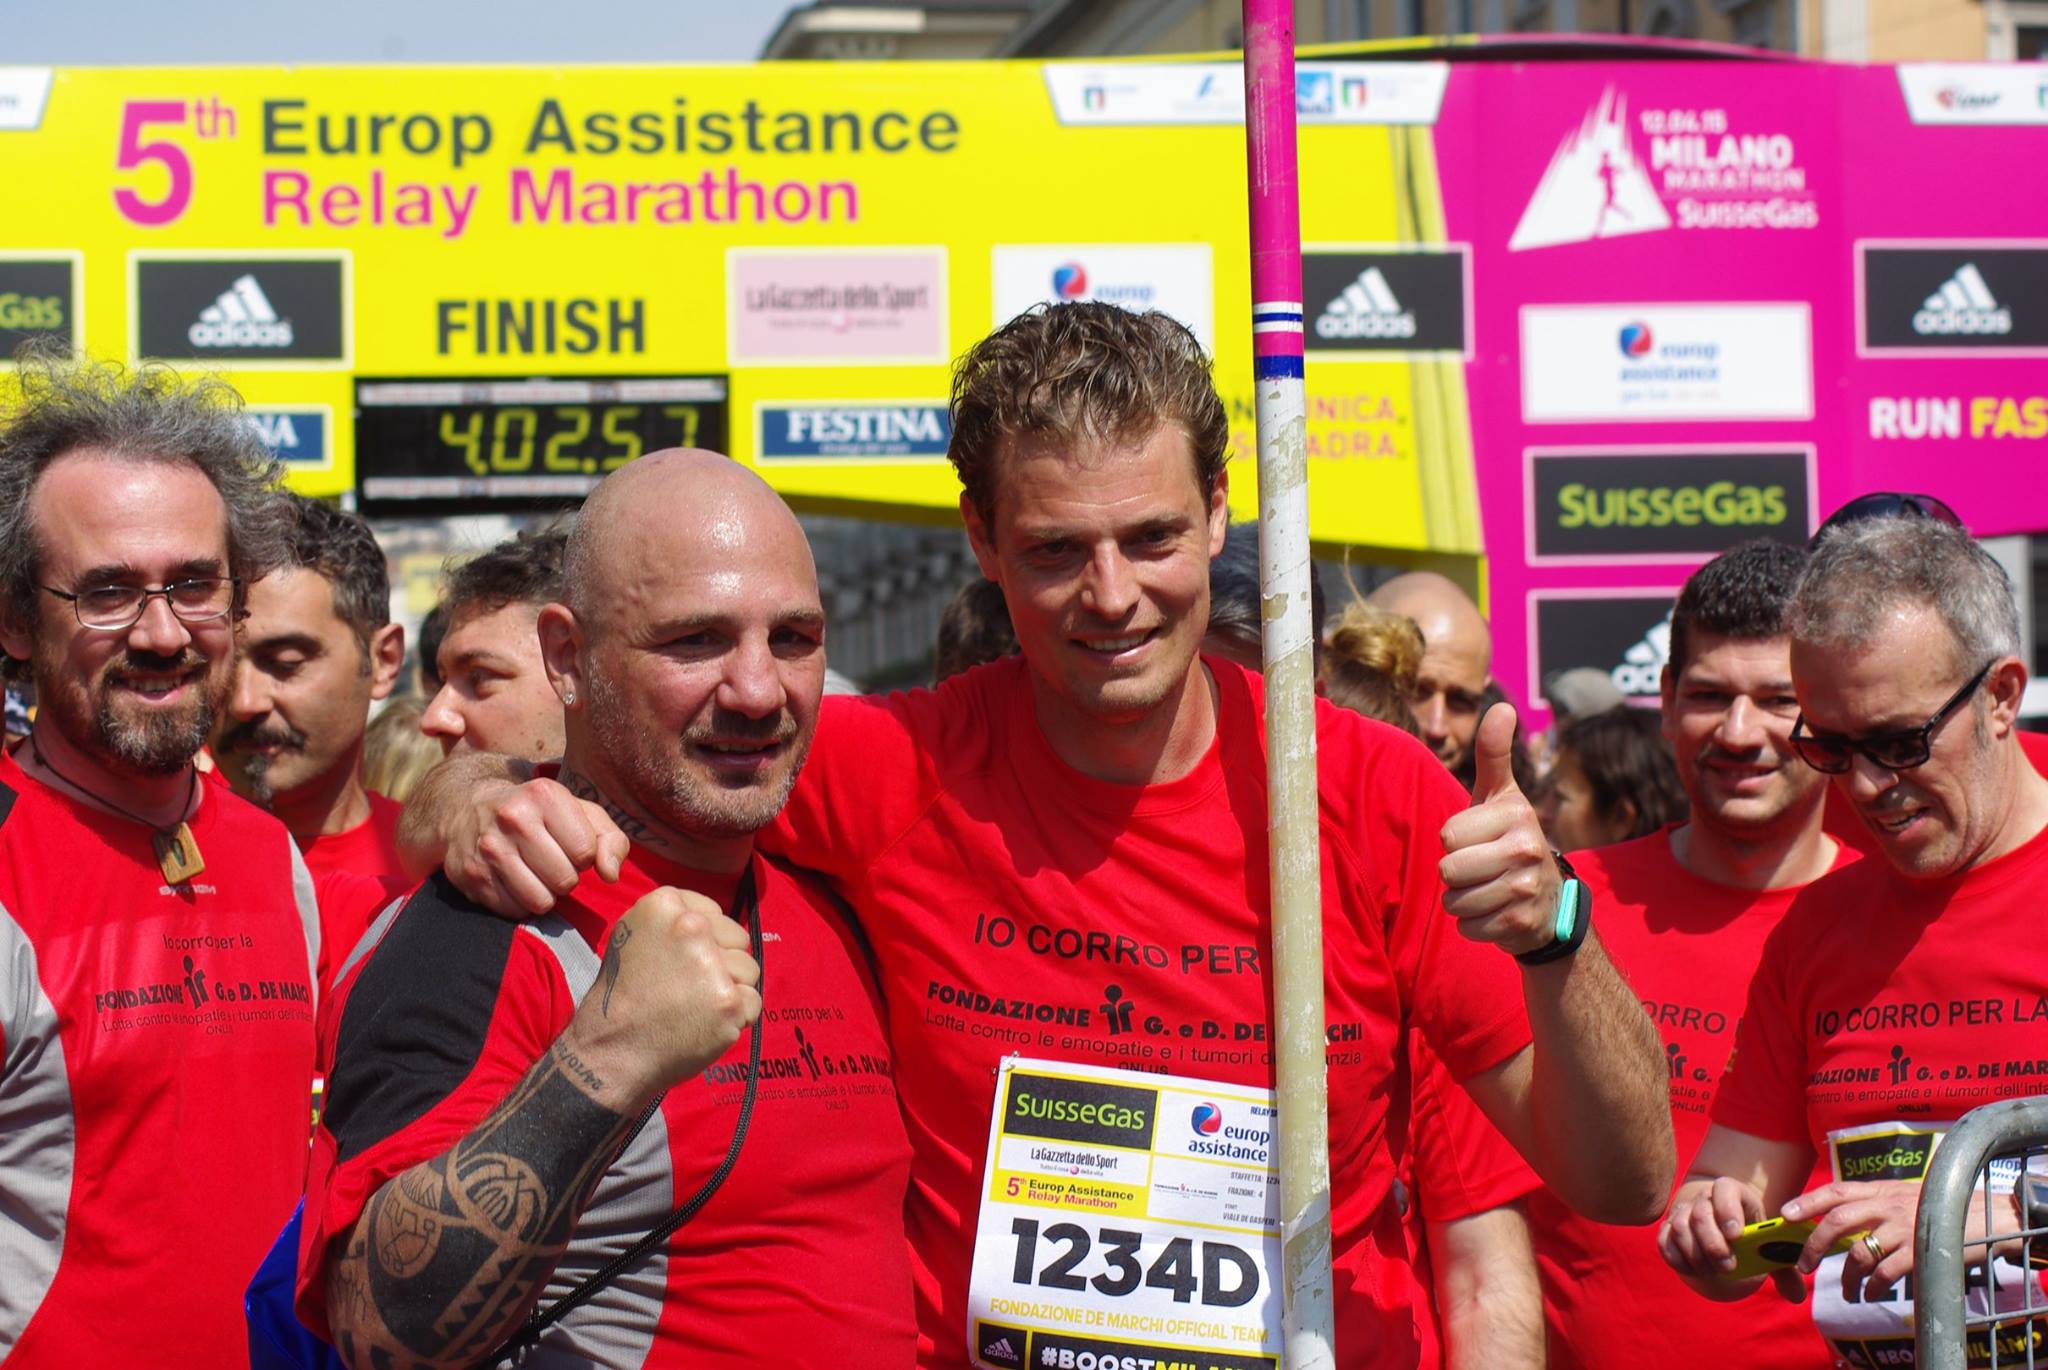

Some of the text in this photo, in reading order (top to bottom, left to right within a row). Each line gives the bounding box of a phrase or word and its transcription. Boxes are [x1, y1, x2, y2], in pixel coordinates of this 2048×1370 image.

[112, 97, 960, 227] 5th Europ Assistance
[1651, 134, 1794, 170] MILANO
[1664, 168, 1806, 190] MARATHON
[263, 167, 859, 238] Relay Marathon
[188, 320, 294, 347] adidas
[436, 299, 646, 354] FINISH
[1314, 310, 1416, 338] adidas
[1911, 307, 2012, 335] adidas
[786, 408, 945, 443] FESTINA
[1869, 396, 1962, 440] RUN
[1557, 481, 1788, 528] SuisseGas
[974, 912, 1260, 975] IO CORRO PER
[95, 984, 185, 1014] FONDAZIONE
[239, 981, 257, 1001] D.
[259, 981, 277, 1001] DE
[926, 980, 1091, 1028] FONDAZIONE
[1143, 1016, 1170, 1037] G.
[1178, 1024, 1194, 1038] e
[1201, 1021, 1227, 1041] D.
[1233, 1022, 1266, 1042] DE
[103, 1019, 133, 1033] Lotta
[137, 1013, 171, 1027] contro
[782, 1007, 813, 1021] corro
[815, 1008, 832, 1024] per
[1641, 1000, 1726, 1035] ORRO
[1815, 996, 2048, 1037] IO CORRO PER LA
[925, 1007, 966, 1034] Lotta
[971, 1022, 1032, 1046] contro
[1038, 1030, 1055, 1048] le
[1062, 1037, 1154, 1060] emopatie
[1160, 1047, 1172, 1060] e
[1191, 1046, 1254, 1066] tumori
[1692, 1067, 1712, 1083] G.
[1916, 1066, 1934, 1081] G.
[1955, 1065, 1973, 1080] D.
[1978, 1062, 2000, 1079] DE
[1014, 1092, 1146, 1131] SuisseGas
[1844, 1088, 1854, 1101] le
[1859, 1087, 1919, 1105] emopatie
[1945, 1084, 1989, 1099] tumori
[1188, 1138, 1268, 1162] assistance
[1224, 1125, 1271, 1147] europ
[1028, 1188, 1118, 1209] Relay Marathon
[1029, 1178, 1064, 1193] Europ
[1068, 1183, 1134, 1201] Assistance
[1011, 1216, 1260, 1308] 1234D
[990, 1297, 1269, 1344] FONDAZIONE DE MARCHI OFFICIAL TEAM
[984, 1347, 1020, 1362] adidas
